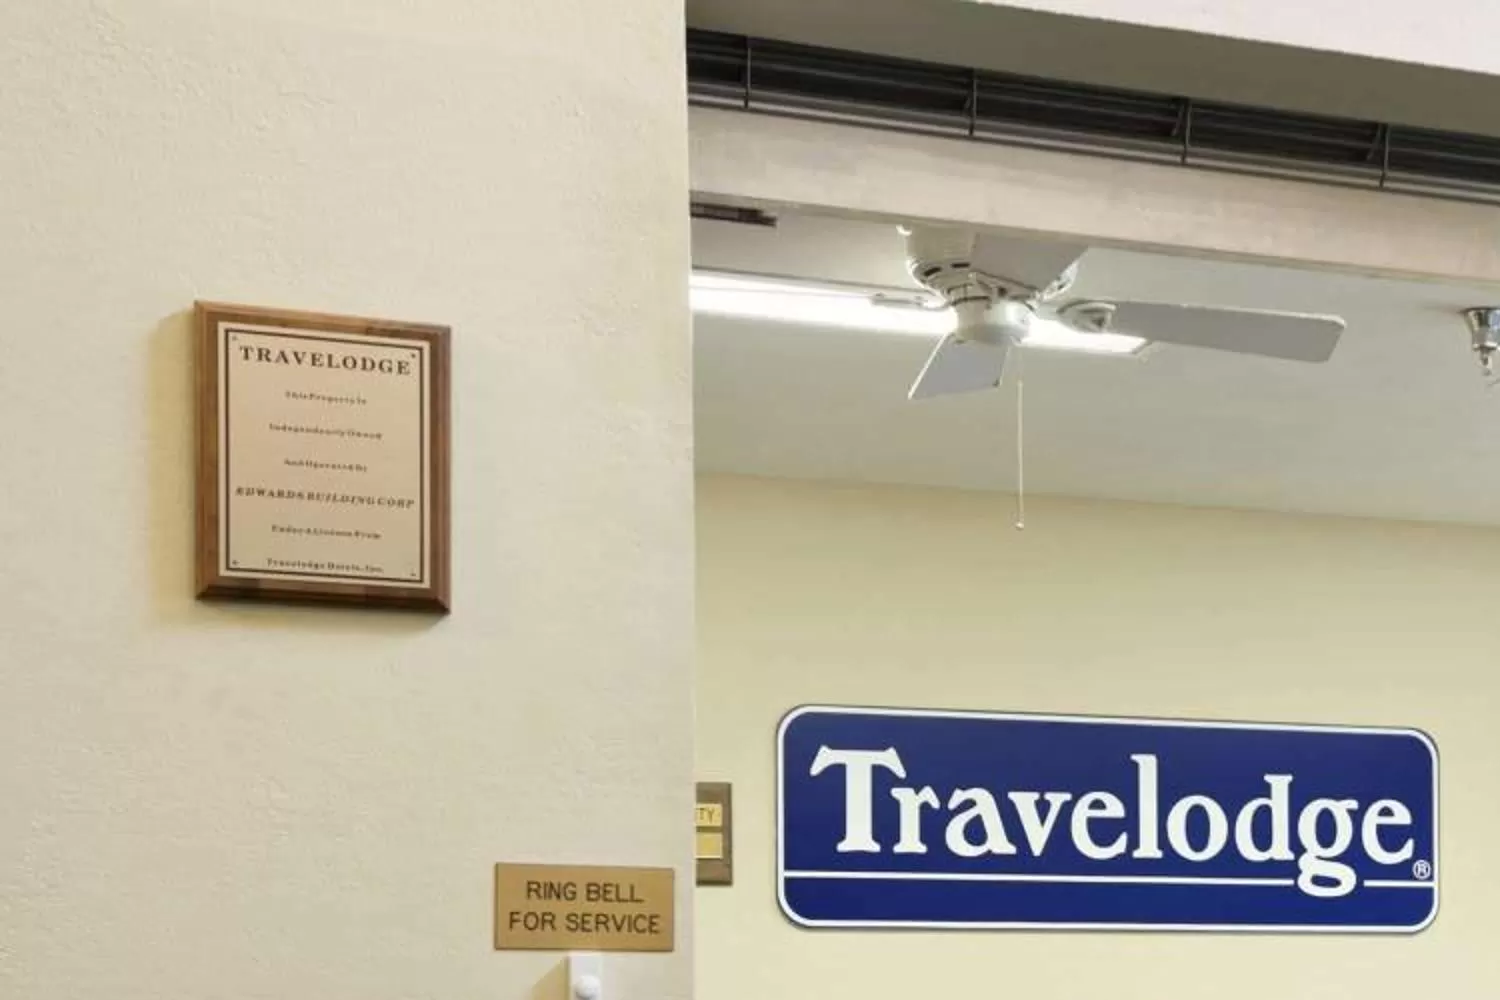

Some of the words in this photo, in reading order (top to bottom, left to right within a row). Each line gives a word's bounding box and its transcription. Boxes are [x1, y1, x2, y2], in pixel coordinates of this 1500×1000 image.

[239, 346, 411, 375] TRAVELODGE
[235, 486, 304, 500] EDWARDS
[307, 491, 375, 505] BUILDING
[810, 745, 1417, 897] Travelodge
[526, 880, 577, 901] RING
[585, 883, 645, 903] BELL
[509, 911, 556, 931] FOR
[565, 913, 661, 934] SERVICE
